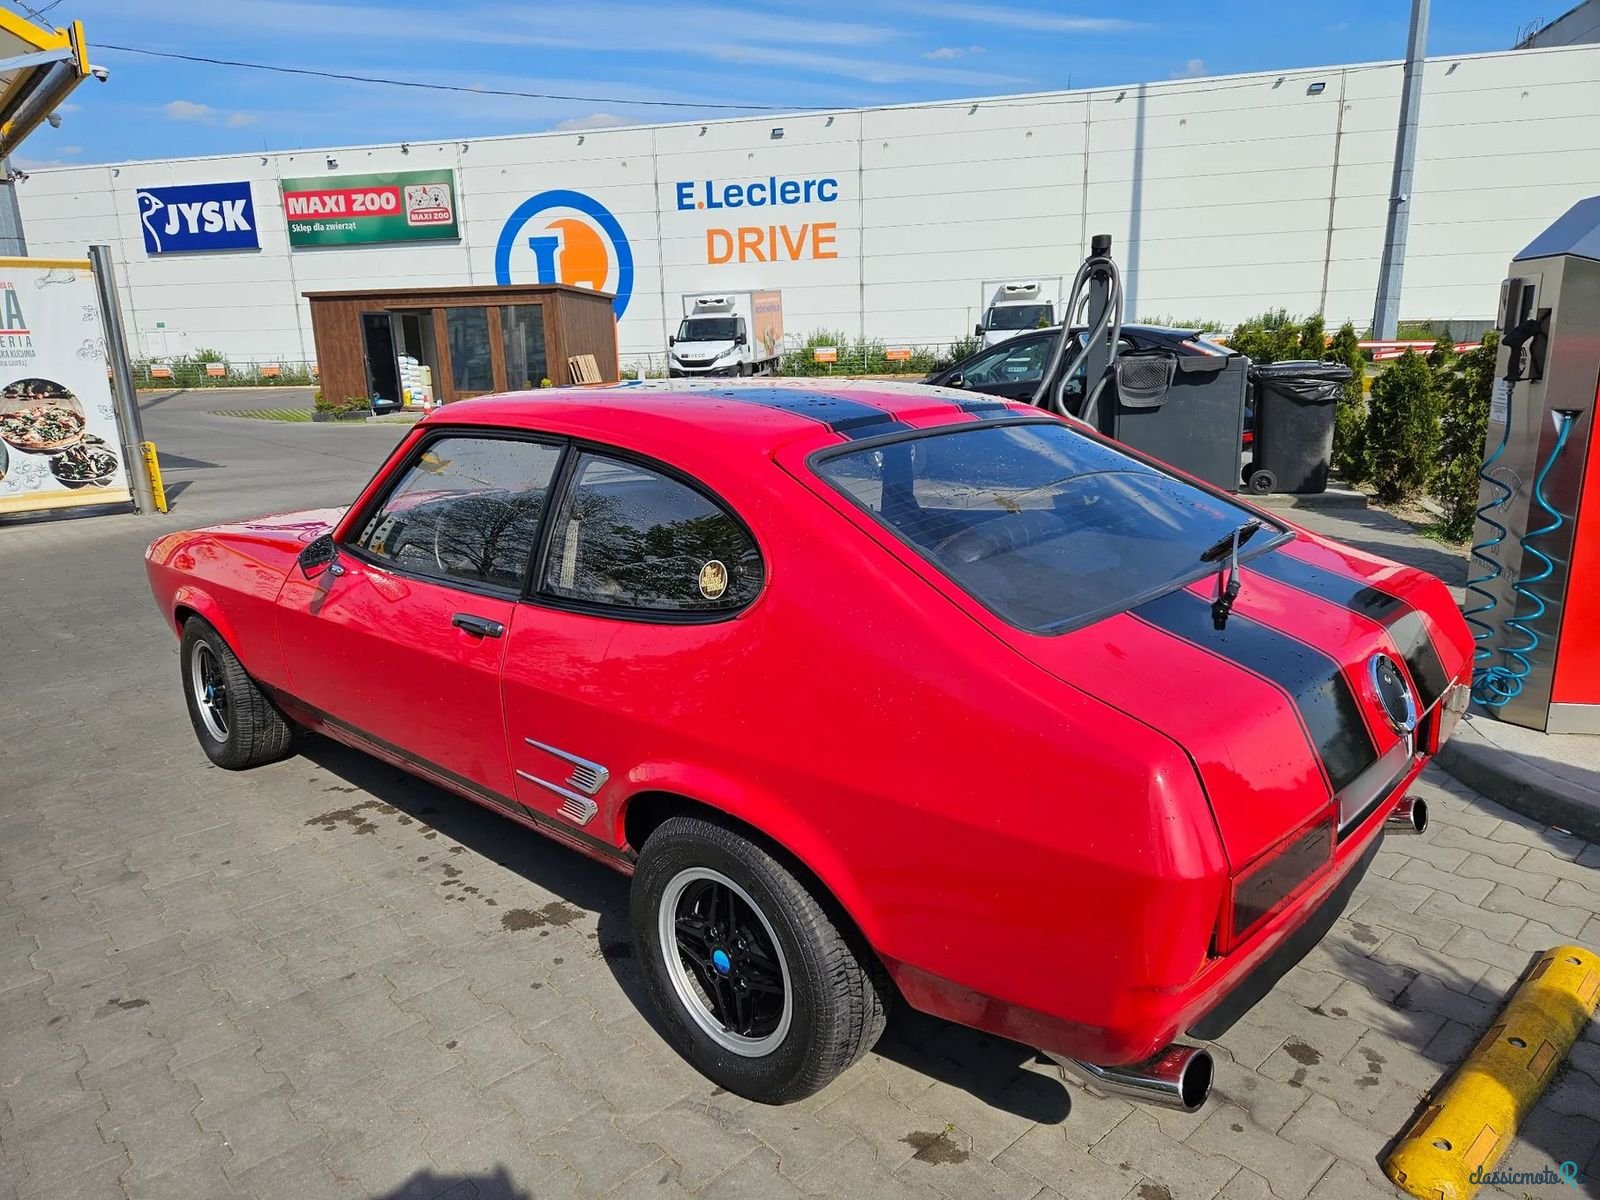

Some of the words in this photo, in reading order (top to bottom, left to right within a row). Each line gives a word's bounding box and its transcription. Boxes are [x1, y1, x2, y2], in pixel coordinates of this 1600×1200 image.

[289, 195, 346, 215] MAXI
[352, 192, 396, 212] ZOO
[676, 176, 838, 210] E.Leclerc
[164, 199, 252, 235] JYSK
[291, 223, 312, 233] Sklep
[313, 223, 325, 231] dla
[325, 221, 357, 231] zwierząt
[411, 213, 432, 221] MAXI
[433, 212, 449, 220] ZOO
[706, 222, 838, 264] DRIVE
